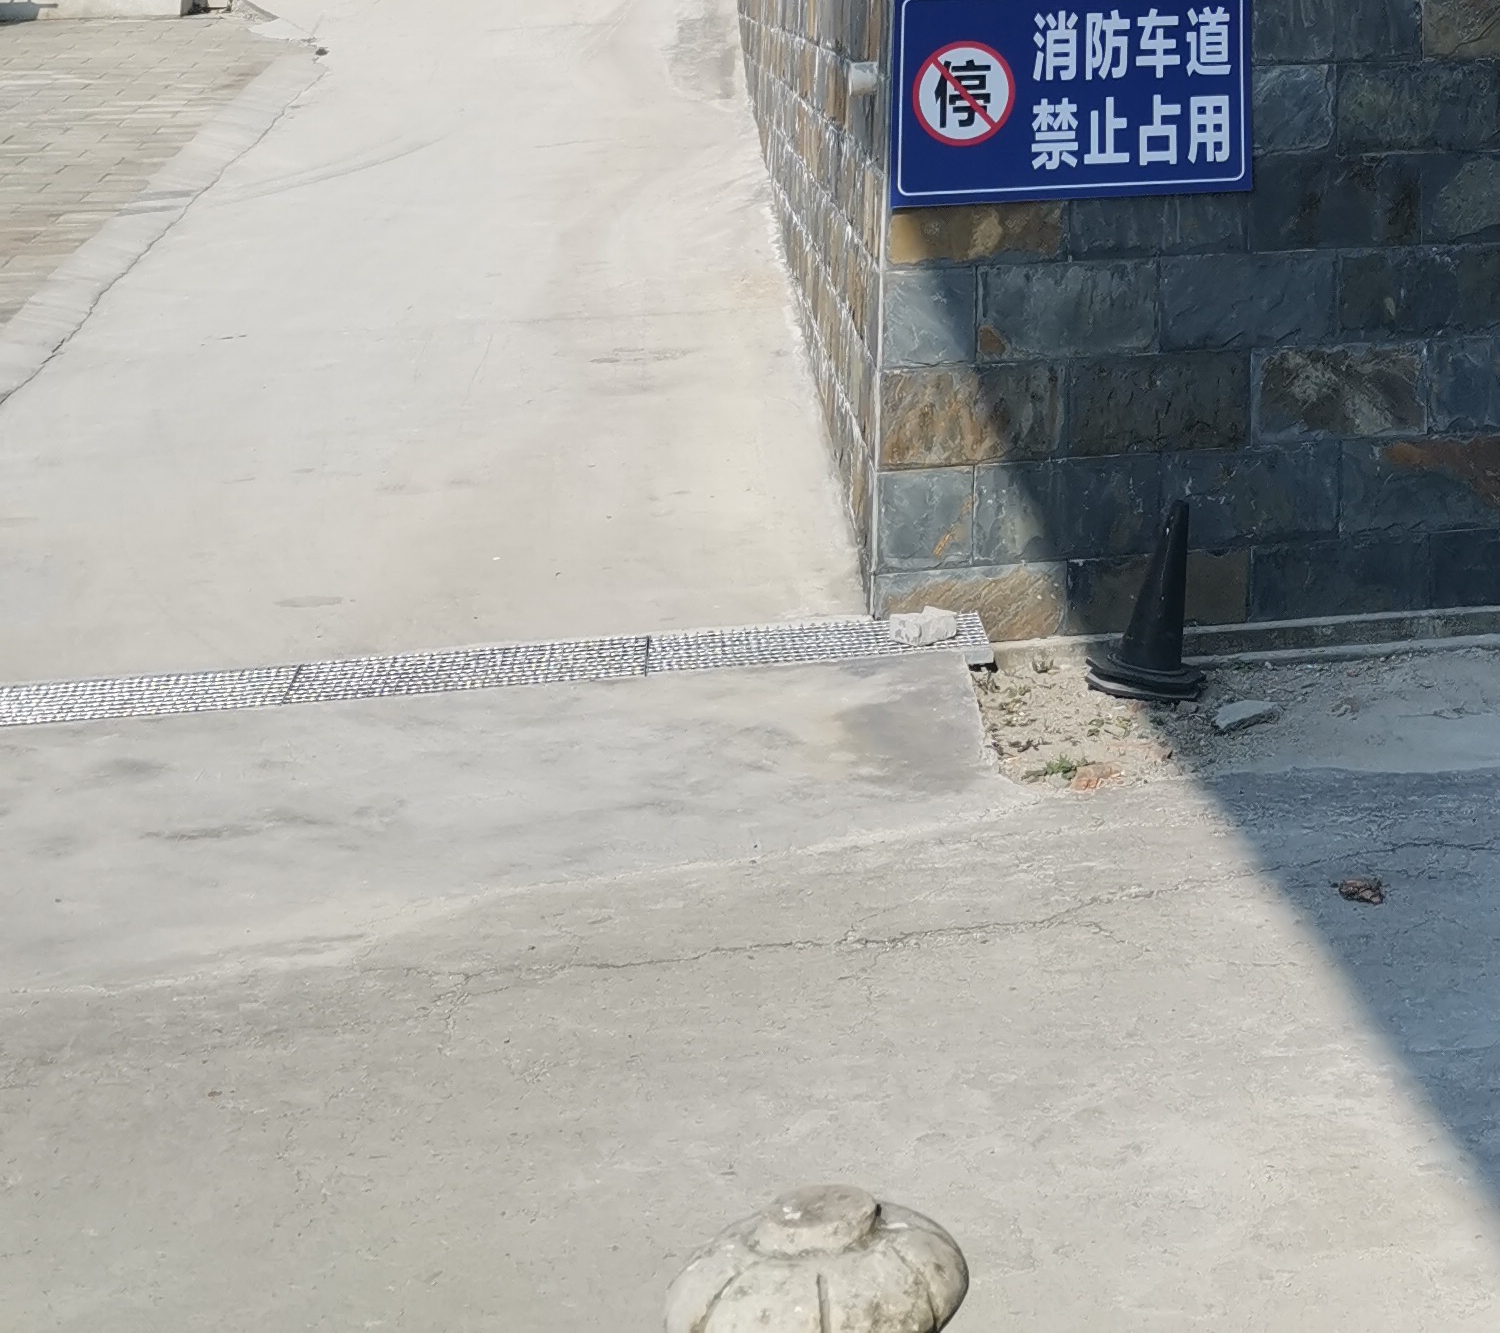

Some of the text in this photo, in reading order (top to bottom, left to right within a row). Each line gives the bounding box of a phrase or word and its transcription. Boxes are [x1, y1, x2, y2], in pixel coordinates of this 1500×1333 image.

[1032, 6, 1232, 82] 消防车道
[1031, 94, 1231, 170] 禁止占用
